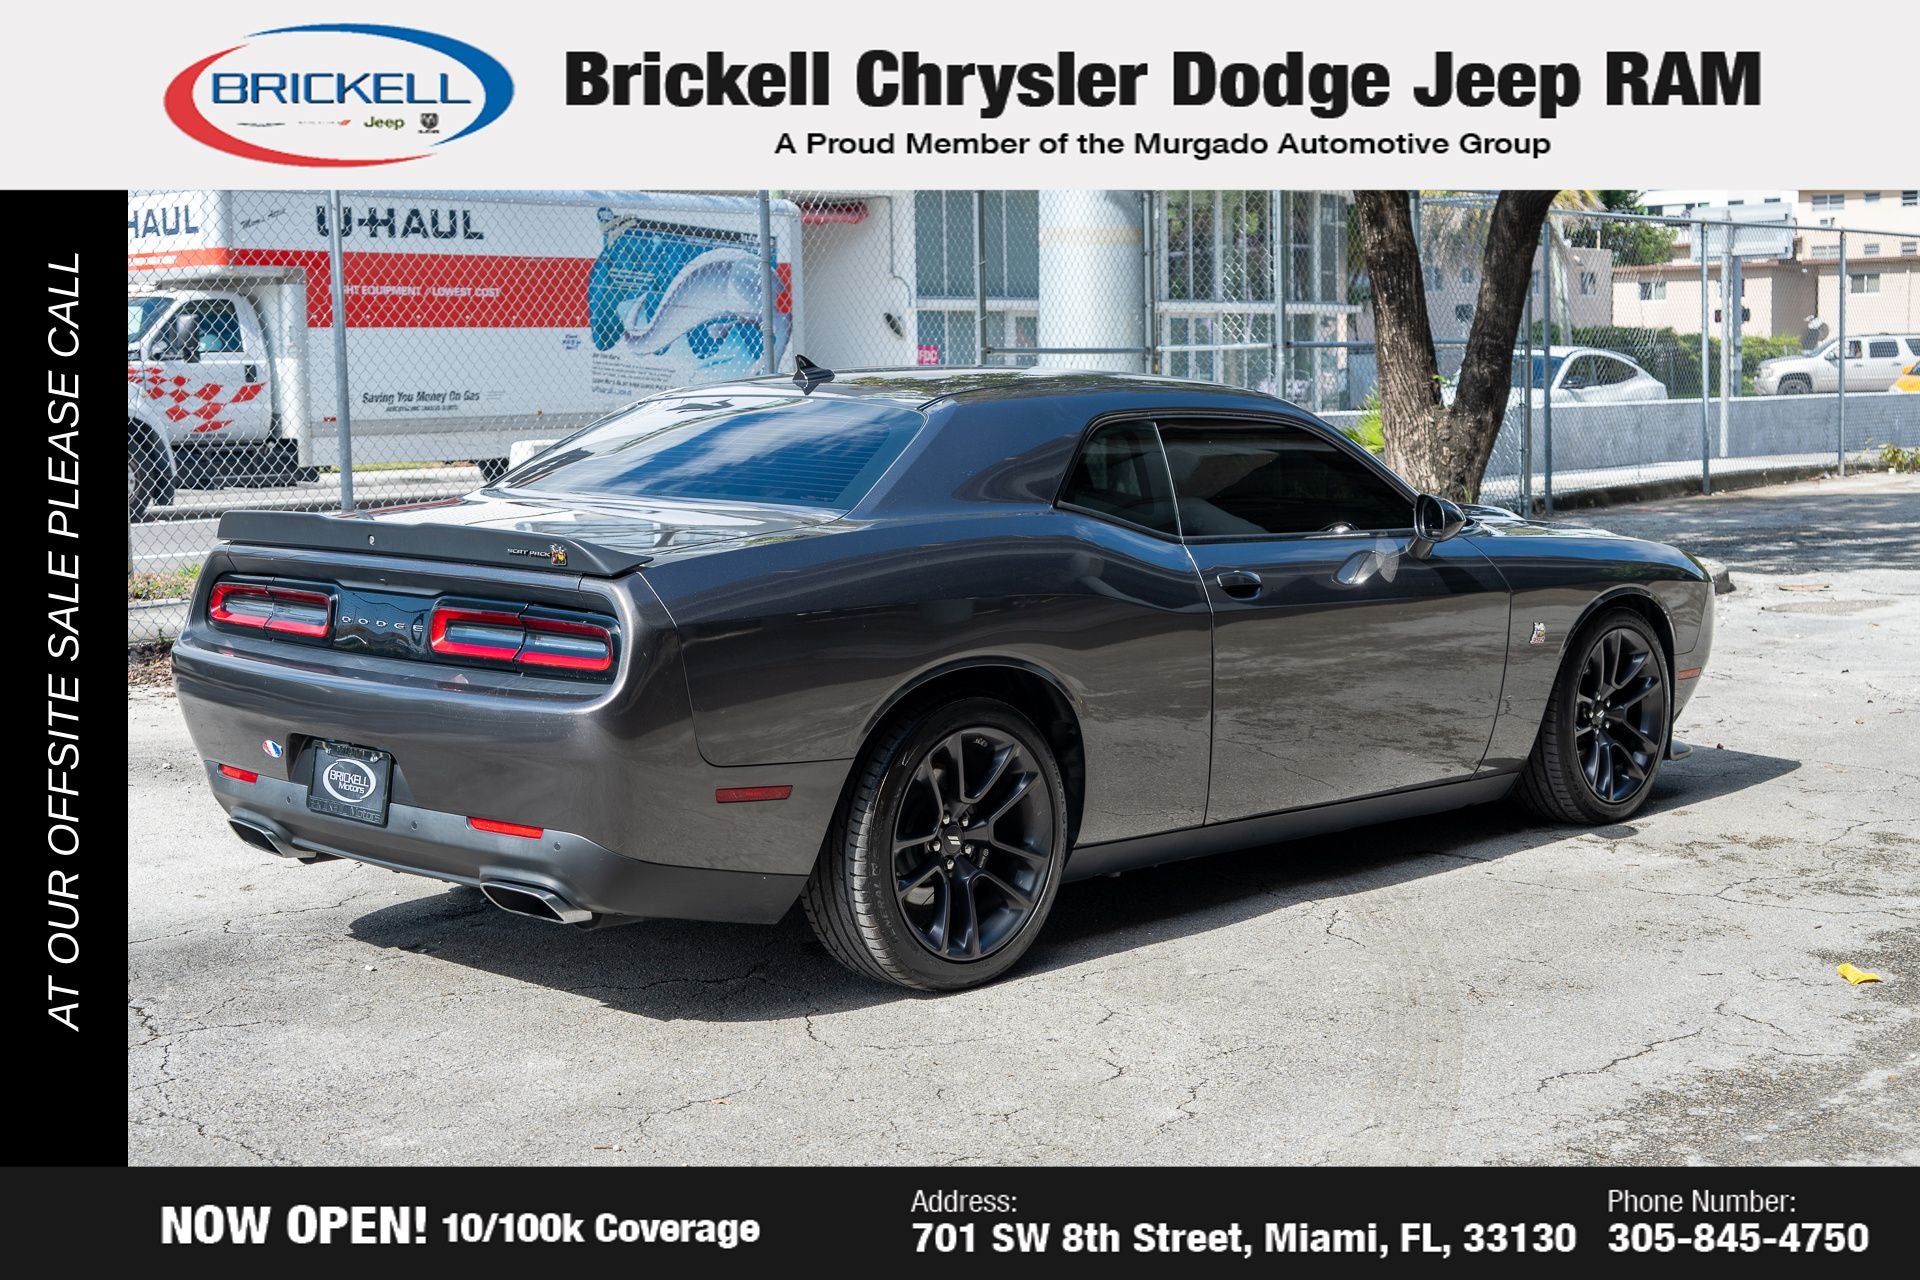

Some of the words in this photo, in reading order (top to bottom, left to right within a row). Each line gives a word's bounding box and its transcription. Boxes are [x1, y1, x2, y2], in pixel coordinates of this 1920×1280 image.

[361, 285, 422, 296] EQUIPMENT
[432, 287, 473, 297] LOWEST
[475, 287, 501, 298] COST
[362, 392, 395, 404] Saving
[397, 391, 414, 402] You
[416, 391, 448, 404] Money
[463, 390, 480, 401] Gas
[342, 616, 424, 632] DODGE
[329, 769, 370, 788] BRICKELL
[338, 781, 365, 794] Motors
